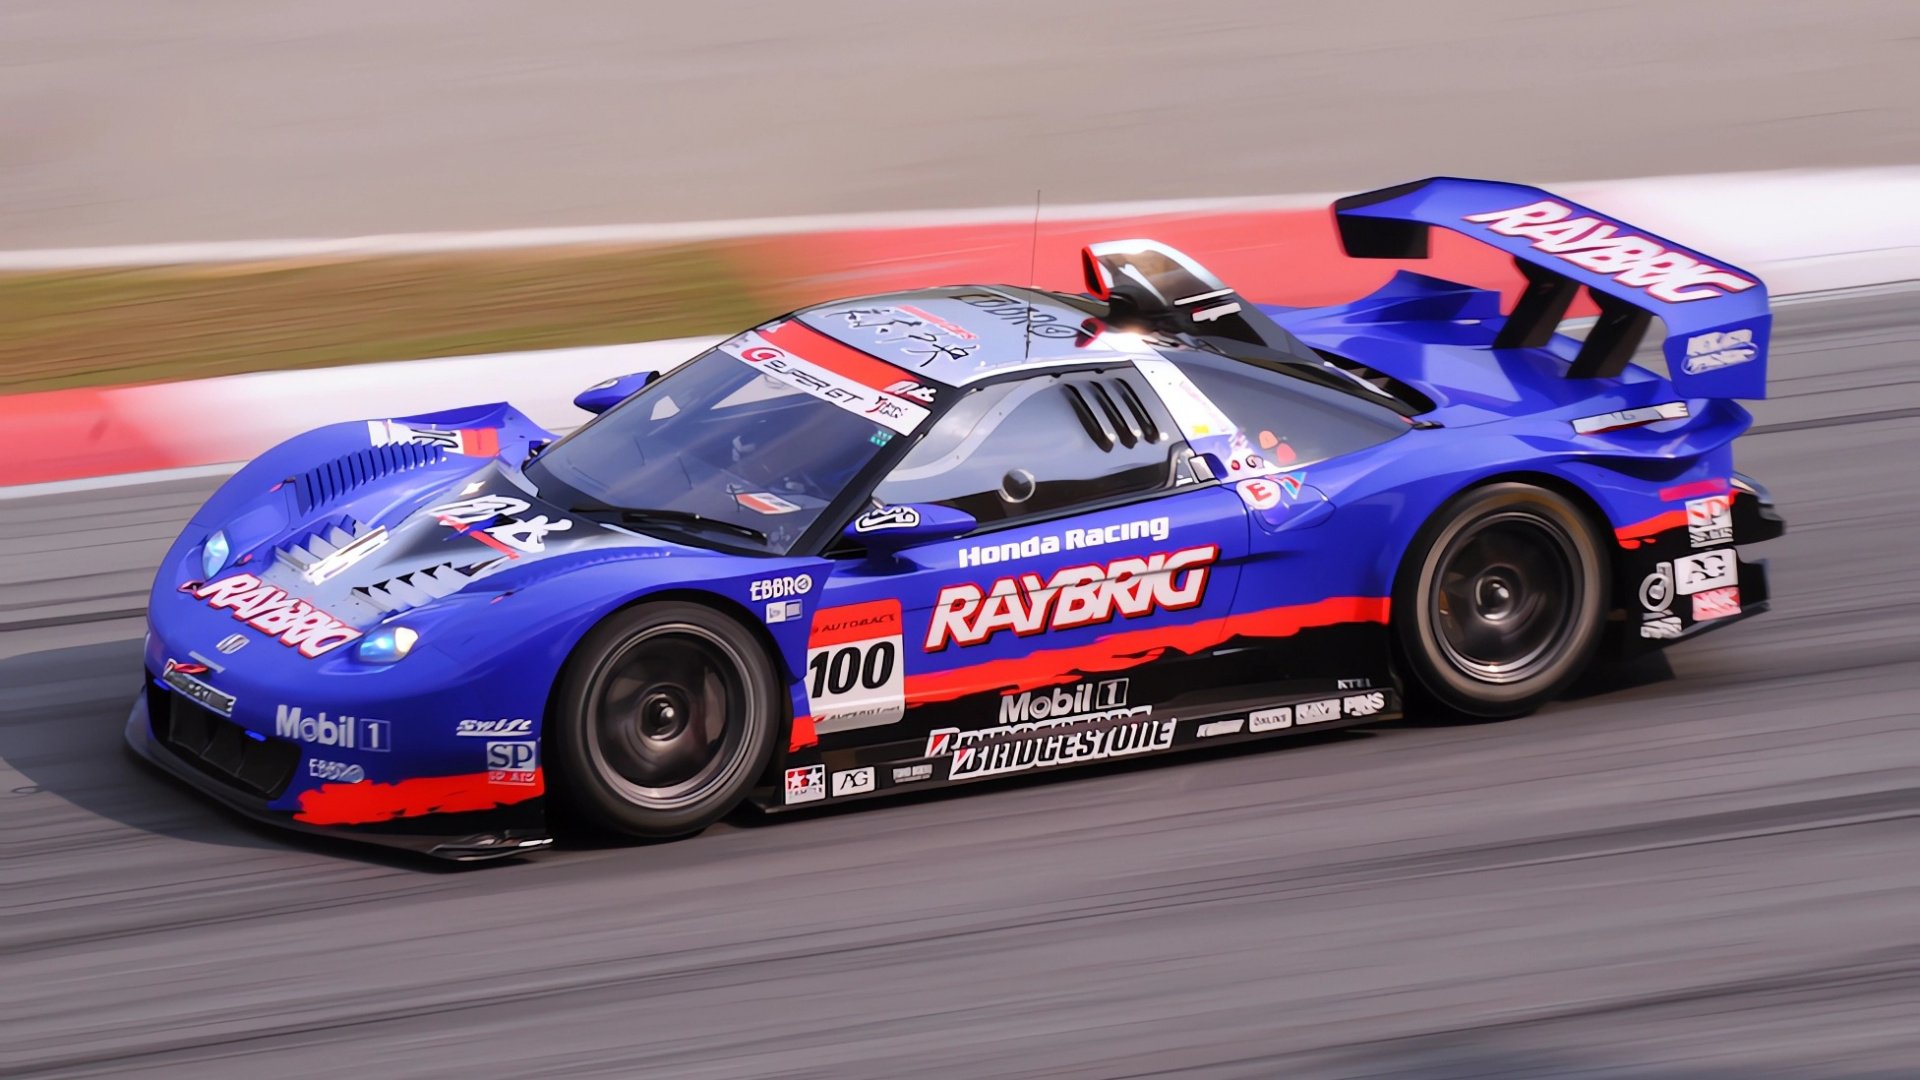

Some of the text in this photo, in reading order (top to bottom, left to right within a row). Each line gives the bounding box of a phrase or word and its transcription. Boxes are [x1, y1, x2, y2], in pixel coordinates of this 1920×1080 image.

[958, 516, 1170, 568] Honda Racing
[750, 573, 813, 601] EBBRO
[923, 543, 1218, 652] RAYBRIG
[809, 640, 895, 699] 100
[999, 683, 1093, 724] Mobil
[275, 704, 355, 748] Mobil
[488, 743, 533, 769] SP
[840, 770, 869, 790] AG
